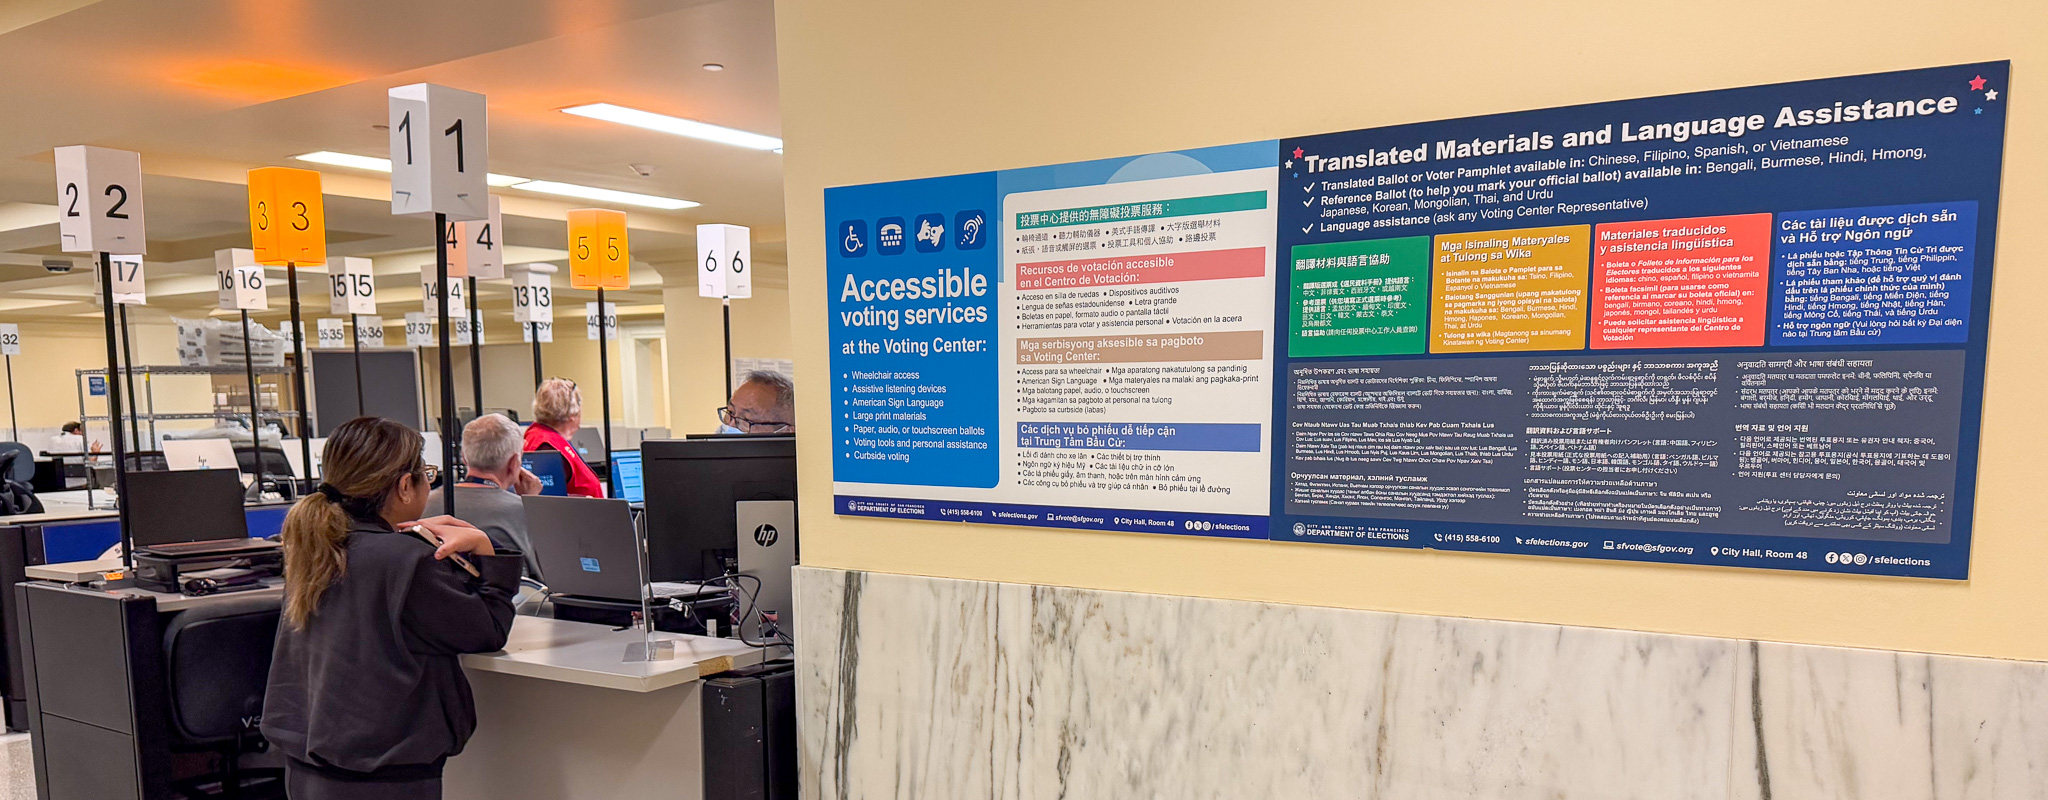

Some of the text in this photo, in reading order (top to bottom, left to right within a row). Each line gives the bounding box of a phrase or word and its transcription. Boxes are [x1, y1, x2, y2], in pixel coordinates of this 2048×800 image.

[398, 110, 412, 165] 1
[1304, 96, 1957, 173] Translated Materials and Language Assistance
[445, 118, 464, 173] 1
[1321, 136, 1848, 191] Translated Ballot or Voter Pamphlet available in: Chinese, Filipino, Spanish, or Vietnamese
[1320, 147, 1926, 205] Reference Ballot (to help you mark your official ballot) available in: Bengali, Burmese, Hindi, Hmong,
[65, 182, 80, 217] 2
[104, 184, 129, 220] 2
[1320, 188, 1553, 219] Japanese, Korean, Mongolian, Thai, and Urdu
[257, 201, 269, 231] 3
[291, 201, 310, 231] 3
[1320, 196, 1648, 232] Language assistance (ask any Voting Center Representative)
[1781, 209, 1957, 230] Các tài liệu được dịch sẵn
[446, 221, 458, 249] 4
[476, 223, 493, 250] 4
[1601, 224, 1726, 240] Materiales traducidos
[577, 236, 590, 260] 5
[607, 237, 620, 262] 5
[1441, 234, 1569, 252] Mga Isinaling Materyales
[1600, 237, 1733, 255] y asistencia lingüística
[706, 249, 717, 272] 6
[732, 250, 744, 273] 6
[1295, 253, 1389, 270] 翻譯材料與語言協助
[1440, 248, 1531, 262] at Tulong sa Wika
[113, 260, 139, 282] 17
[1020, 256, 1174, 275] Recursos de votación accesible
[218, 269, 234, 290] 16
[238, 269, 262, 290] 16
[330, 274, 347, 298] 15
[348, 274, 373, 297] 15
[840, 266, 987, 302] Accessible
[1020, 271, 1139, 288] en el Centro de Votación:
[514, 286, 529, 307] 13
[531, 286, 550, 307] 13
[1109, 288, 1148, 297] Dispositivos
[1153, 296, 1177, 306] grande
[840, 301, 987, 331] voting services
[319, 328, 328, 340] 35
[329, 328, 344, 340] 35
[368, 326, 383, 338] 36
[406, 322, 416, 335] 37
[418, 322, 431, 334] 37
[457, 321, 468, 333] 38
[2, 333, 18, 345] 32
[842, 337, 986, 357] at the Voting Center:
[1020, 335, 1203, 352] Mga serbisyong aksesible sa pagboto
[1020, 351, 1099, 363] sa Voting Center:
[851, 370, 920, 379] Wheelchair access
[851, 383, 946, 395] Assistive listening devices
[853, 423, 985, 435] Paper, audio, or touchscreen ballots
[853, 450, 909, 463] Curbside voting
[757, 524, 776, 547] hp
[1306, 528, 1354, 537] DEPARTMENT
[1367, 531, 1409, 540] ELECTIONS
[1444, 533, 1500, 543] (415) 558-6100
[1525, 537, 1588, 548] sfelections.gov
[1616, 542, 1693, 554] sfvote@sfgov.org
[1721, 547, 1807, 559] City Hall, Room 48
